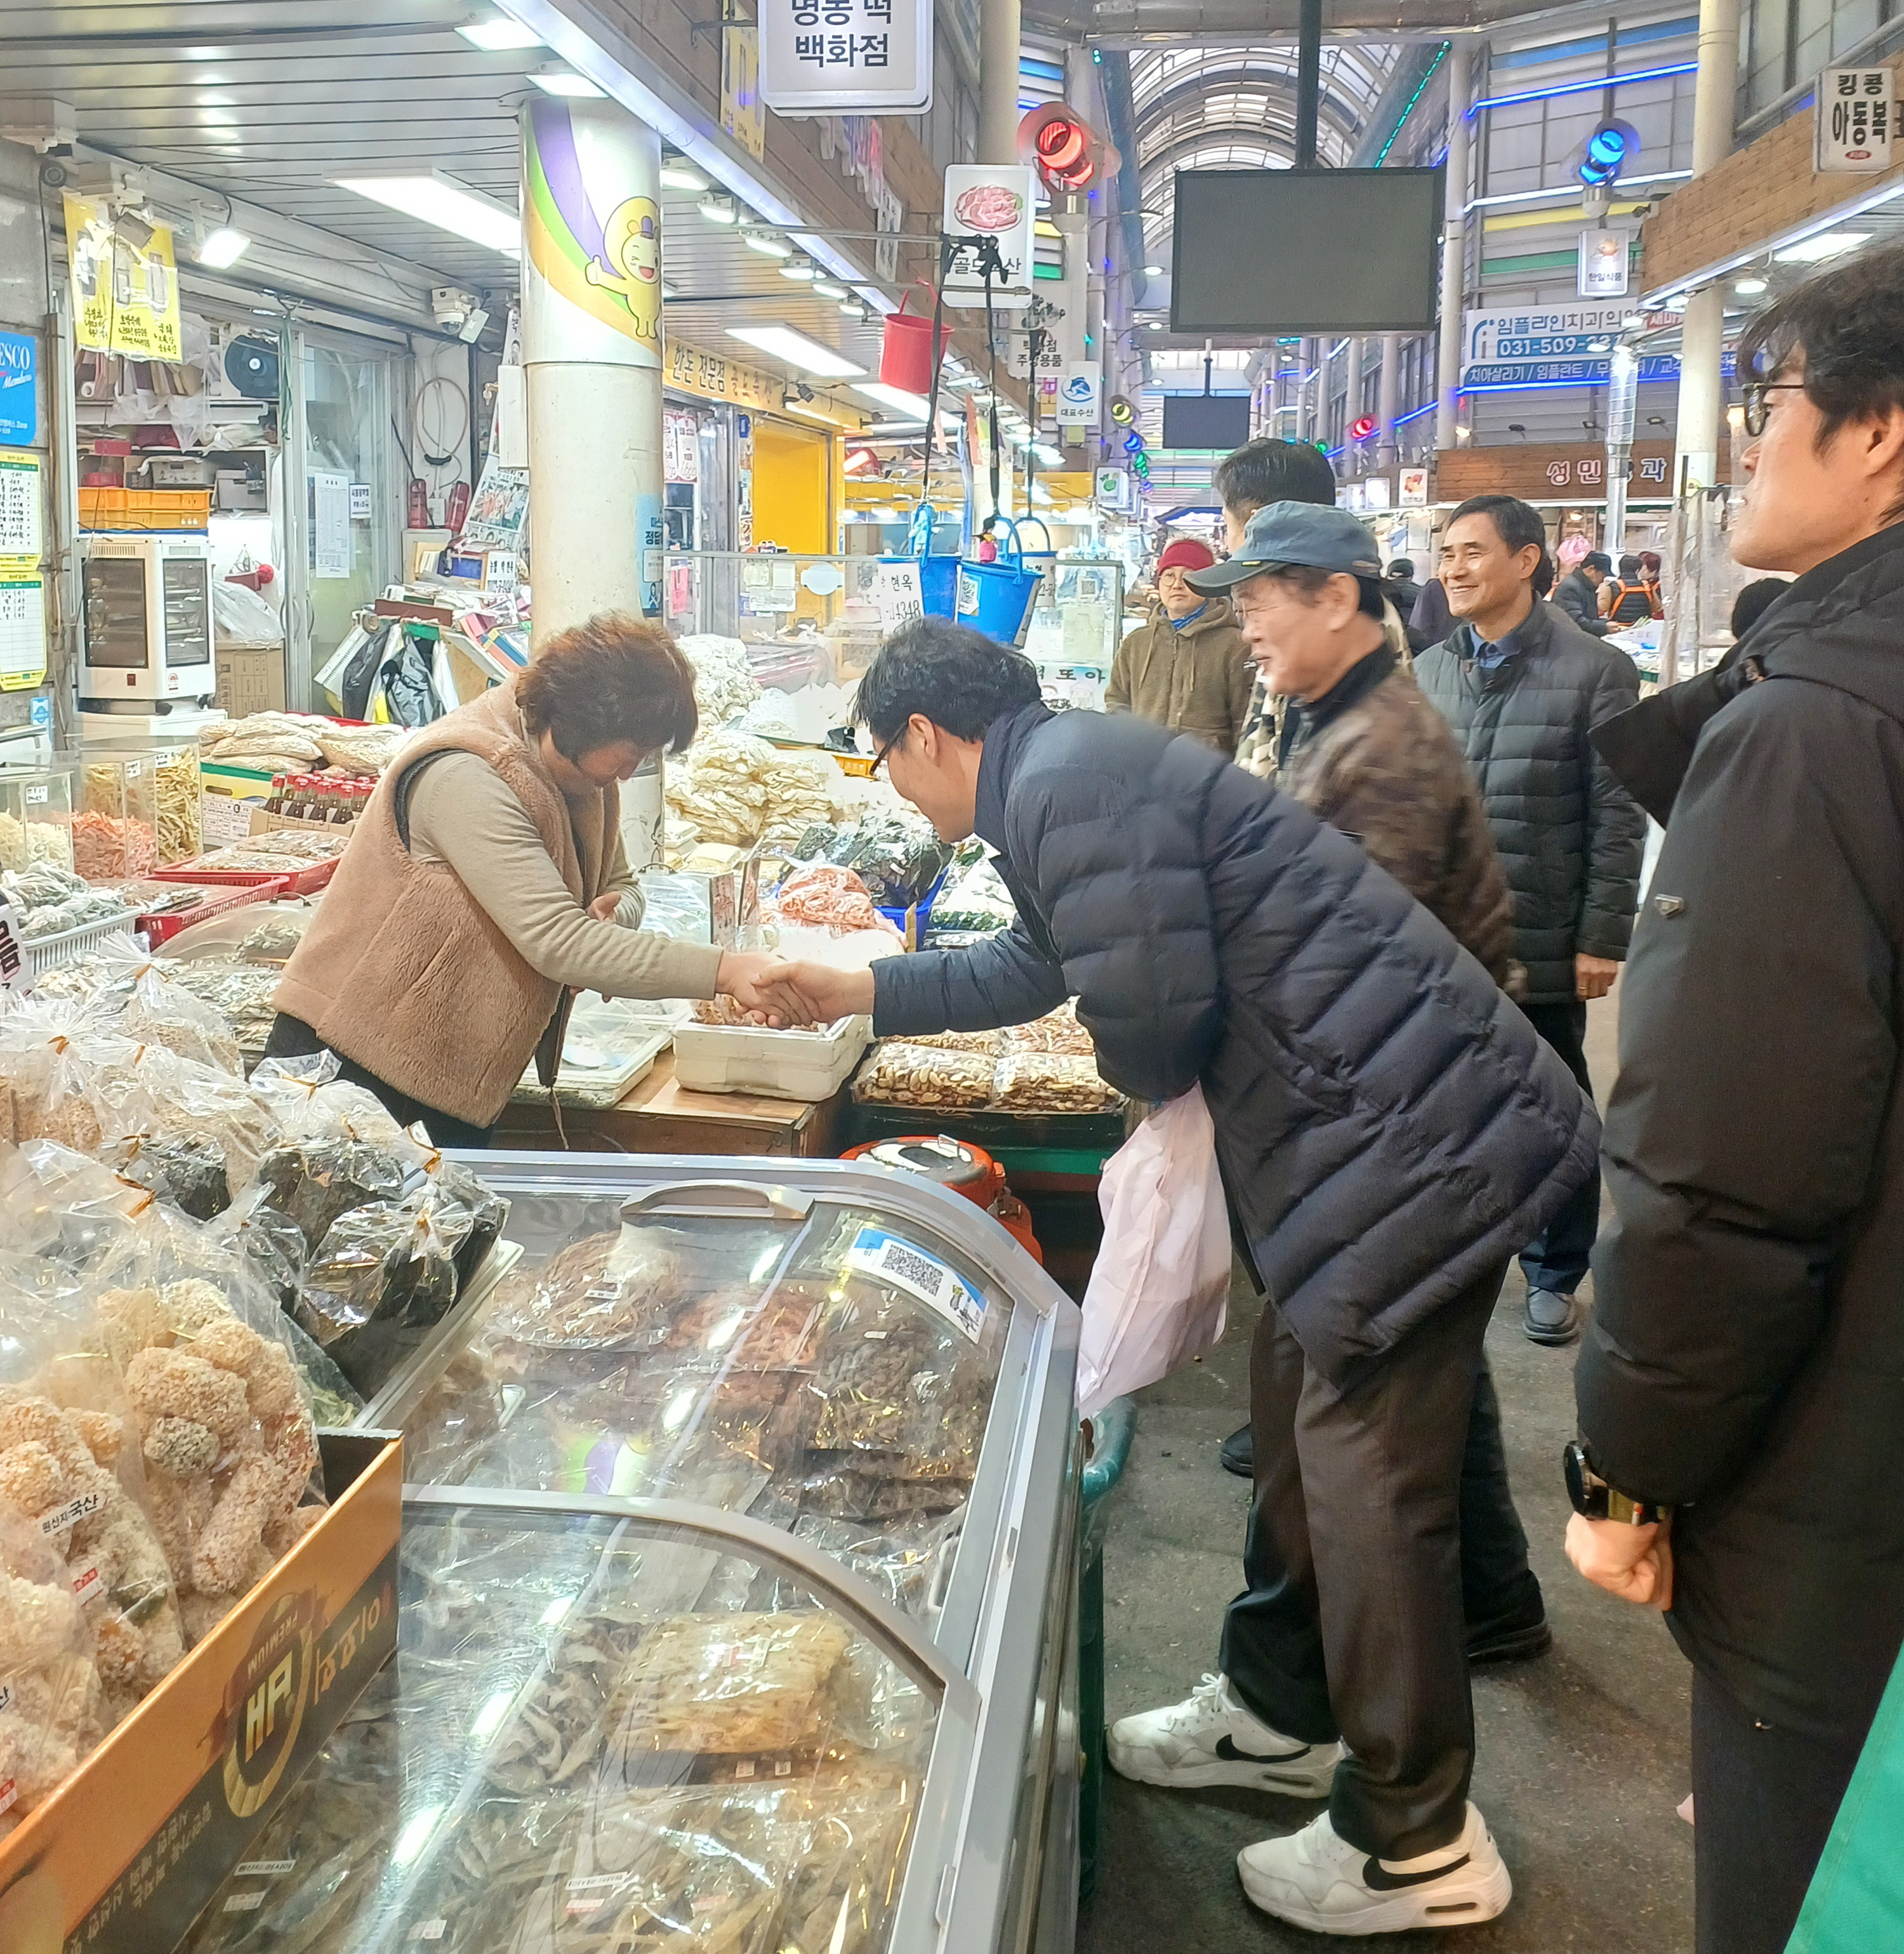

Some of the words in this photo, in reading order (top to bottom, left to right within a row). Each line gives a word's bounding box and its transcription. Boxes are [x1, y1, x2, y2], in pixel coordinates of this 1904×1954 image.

[796, 34, 889, 67] 백화점
[1837, 73, 1884, 95] 킹콩
[1832, 100, 1887, 145] 아동복
[954, 257, 1021, 274] 골드산
[1589, 272, 1622, 282] 한일식품
[673, 343, 694, 384] 한돈
[699, 354, 725, 393] 전문점
[1469, 366, 1524, 382] 치아살리기
[1537, 363, 1583, 380] 임플란트
[1061, 409, 1094, 417] 대표수산
[1546, 458, 1667, 485] 성민과
[248, 1609, 298, 1680] PREMIUM
